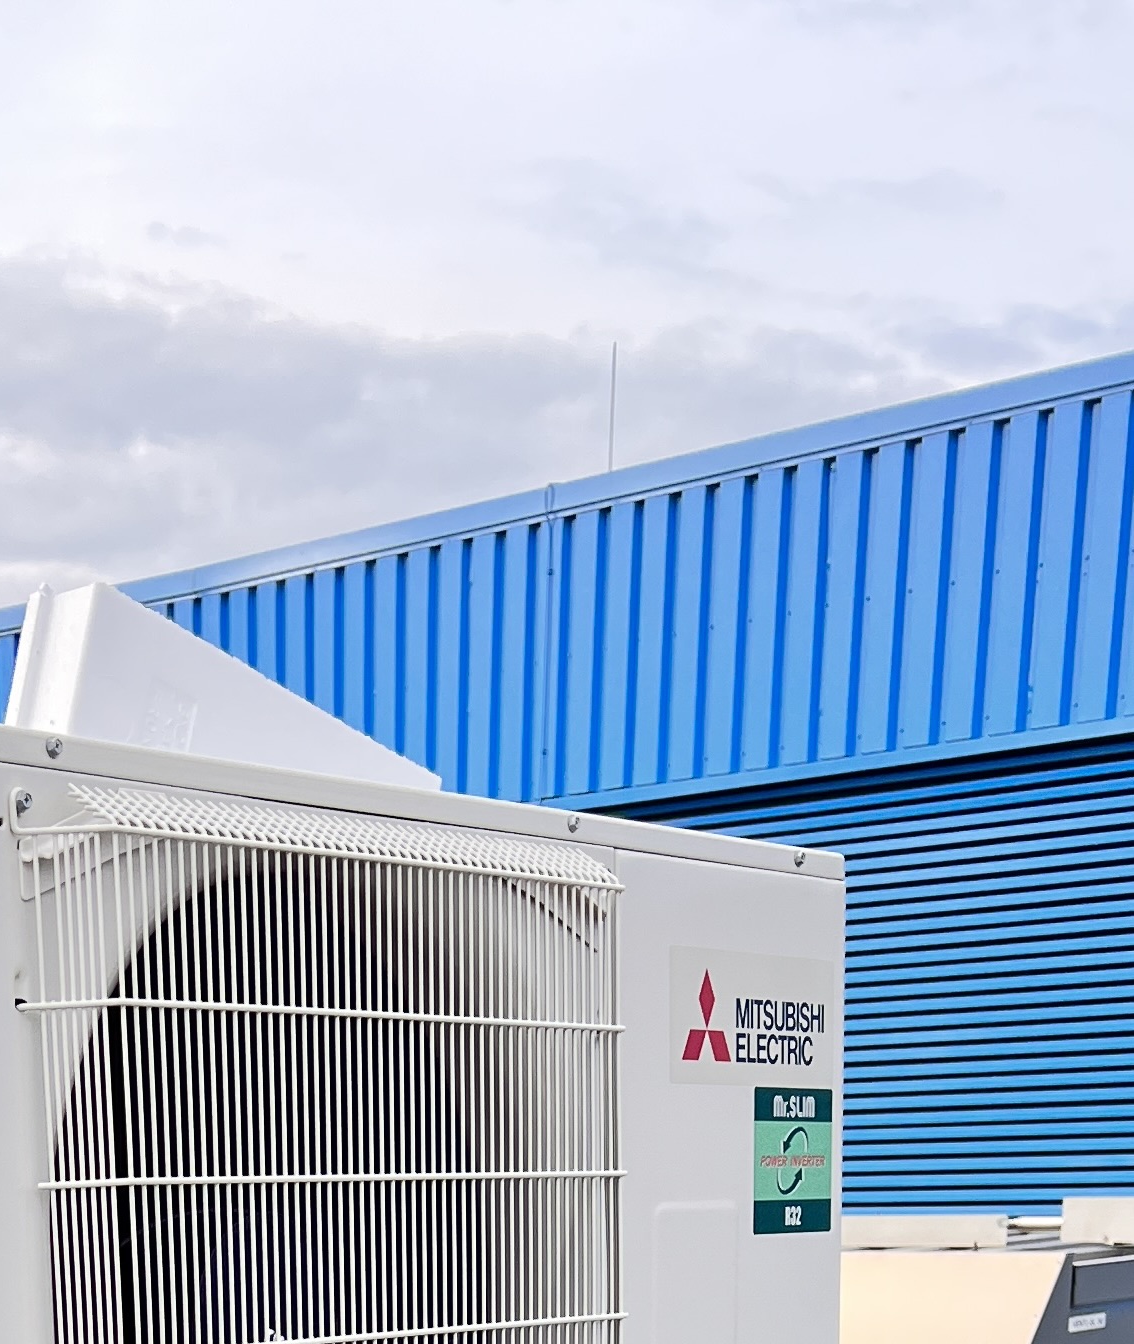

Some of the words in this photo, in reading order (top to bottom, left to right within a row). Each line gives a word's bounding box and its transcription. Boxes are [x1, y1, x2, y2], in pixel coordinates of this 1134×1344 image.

[735, 997, 825, 1034] MITSUBISHI
[735, 1032, 814, 1067] ELECTRIC
[760, 1155, 788, 1168] POWER
[790, 1155, 825, 1168] INVERTER
[784, 1205, 802, 1226] R32
